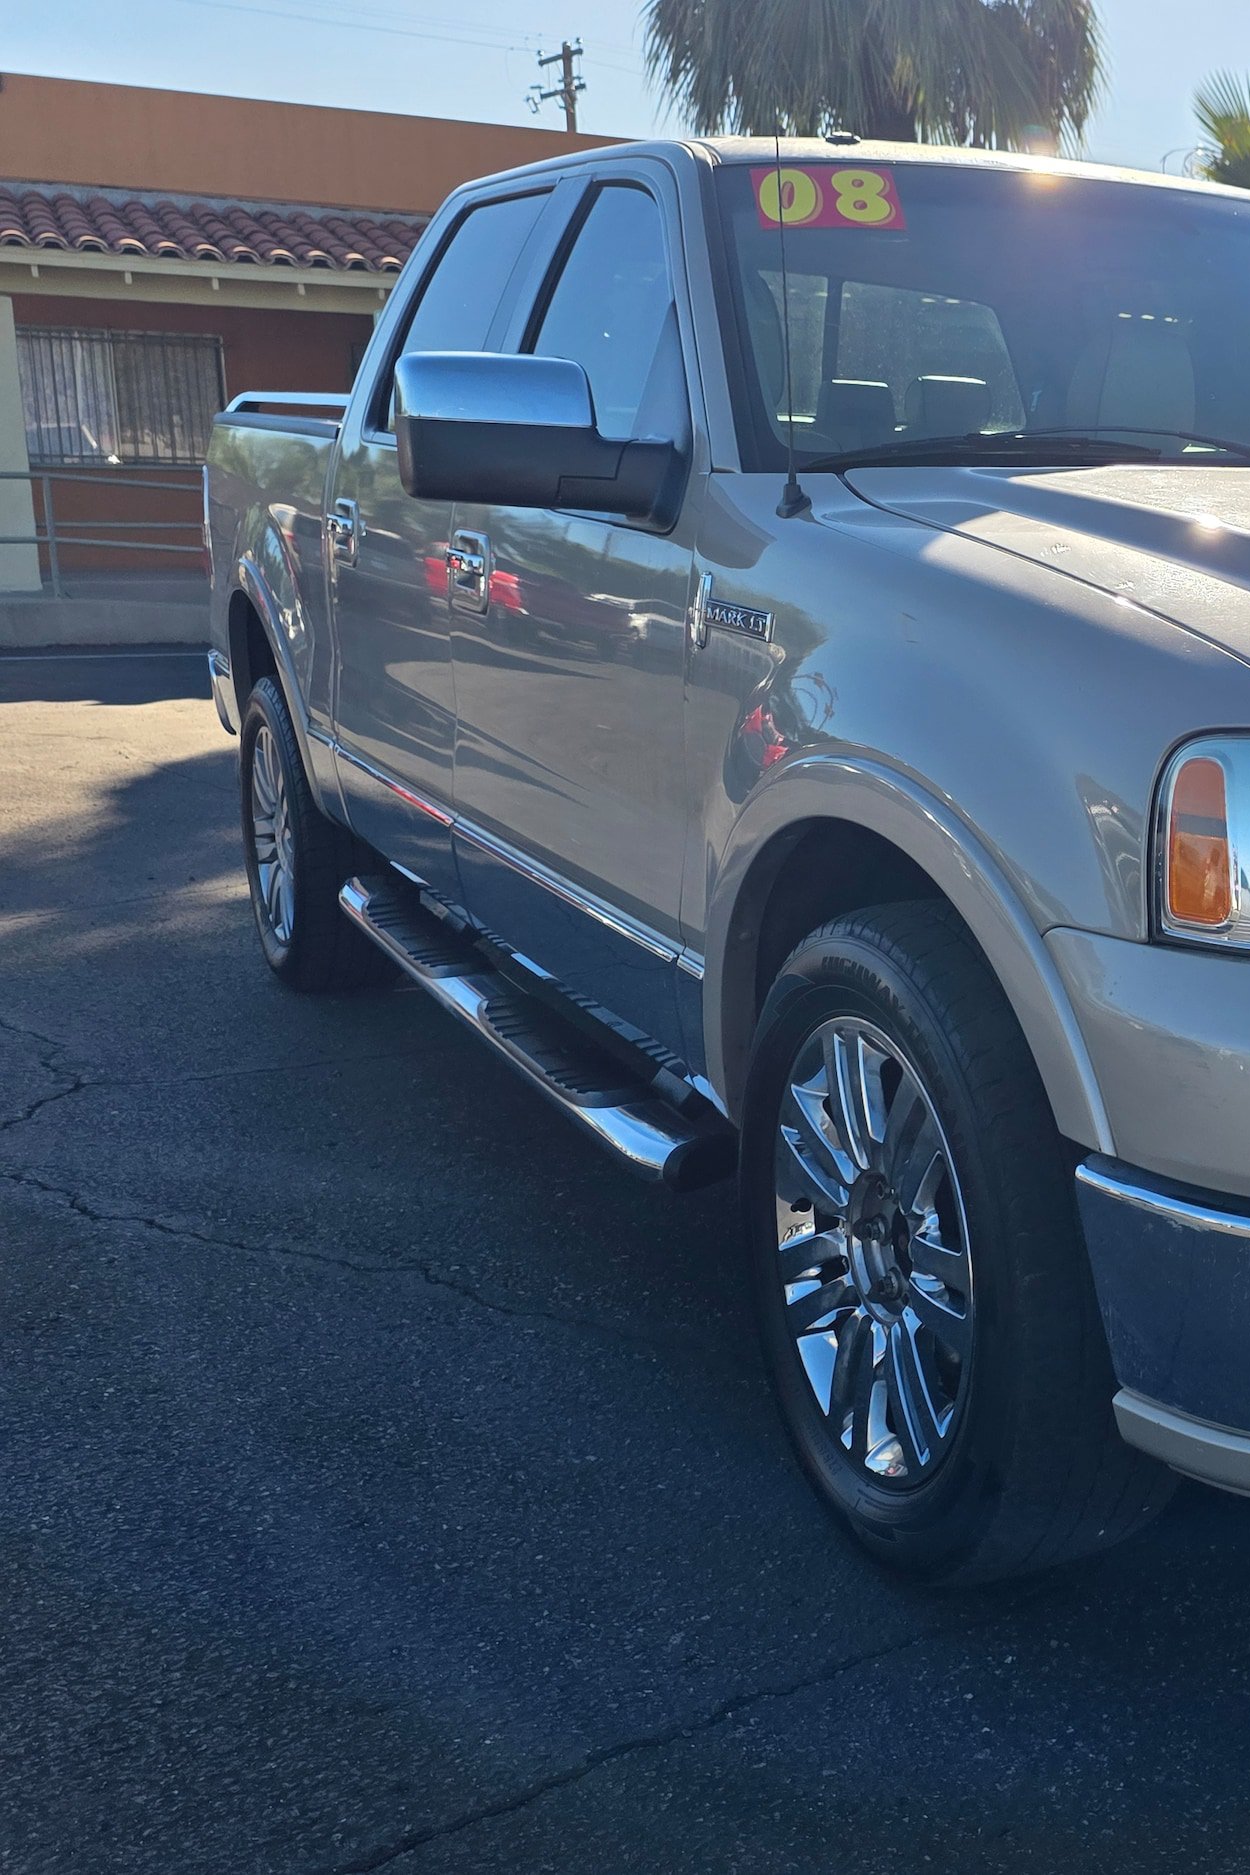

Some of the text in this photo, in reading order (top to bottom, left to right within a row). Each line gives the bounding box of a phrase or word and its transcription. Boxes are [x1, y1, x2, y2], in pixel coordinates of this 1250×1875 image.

[759, 168, 896, 225] 08
[707, 606, 766, 632] MARK LT
